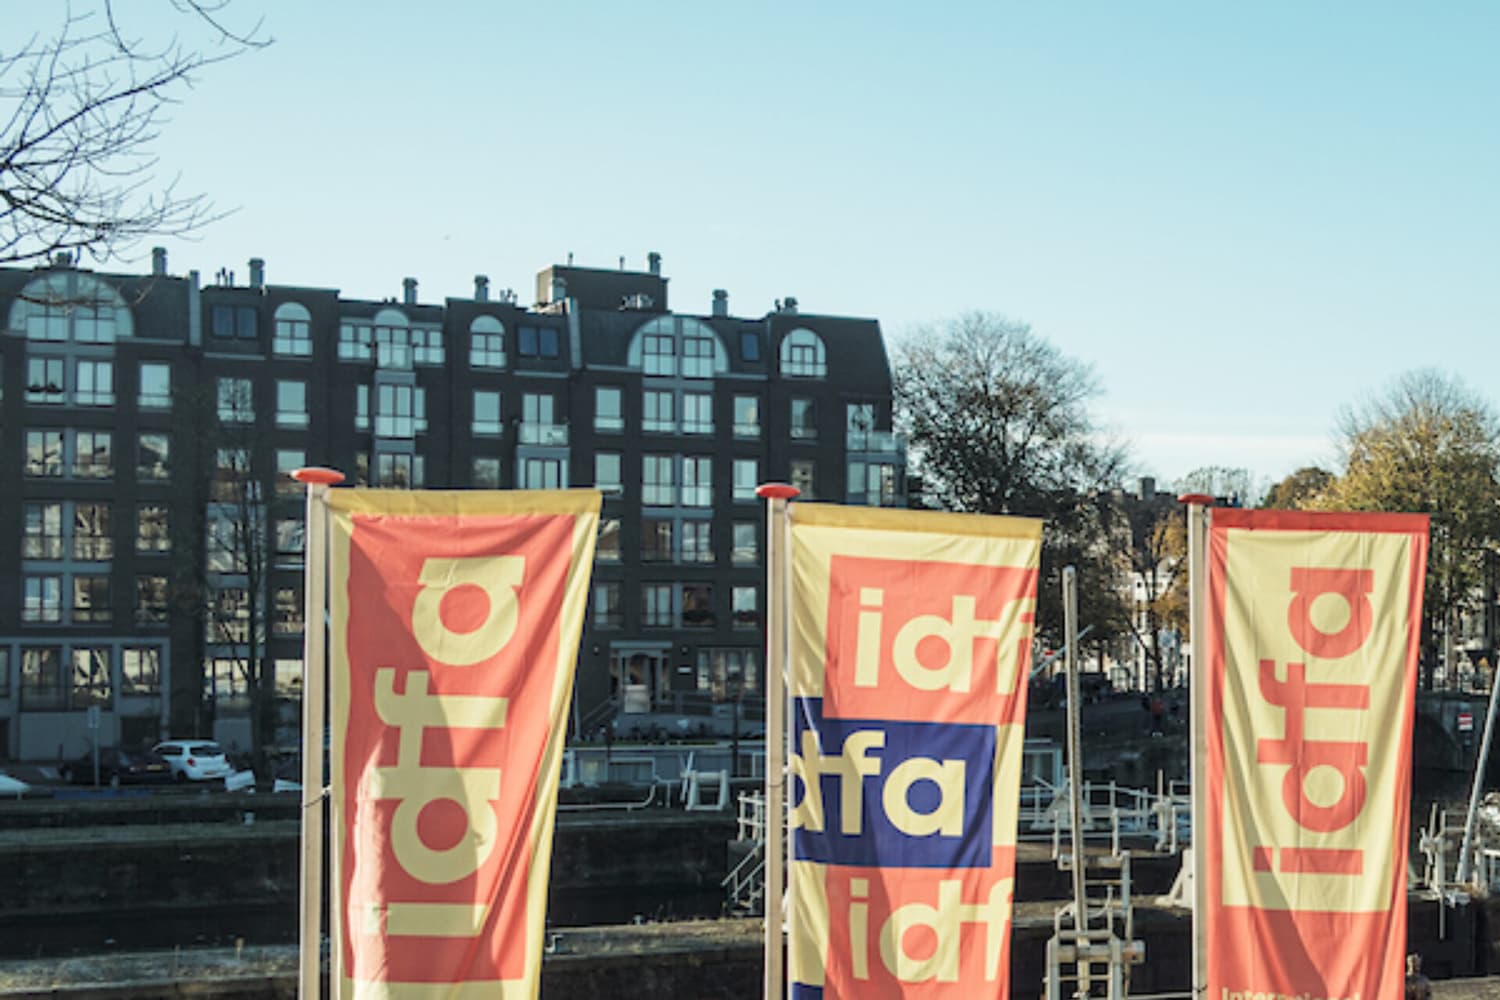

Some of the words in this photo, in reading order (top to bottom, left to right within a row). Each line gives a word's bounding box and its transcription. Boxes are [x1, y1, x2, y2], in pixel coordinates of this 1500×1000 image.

[364, 555, 526, 938] idfa
[854, 587, 1037, 695] idf
[1253, 566, 1374, 876] idfa
